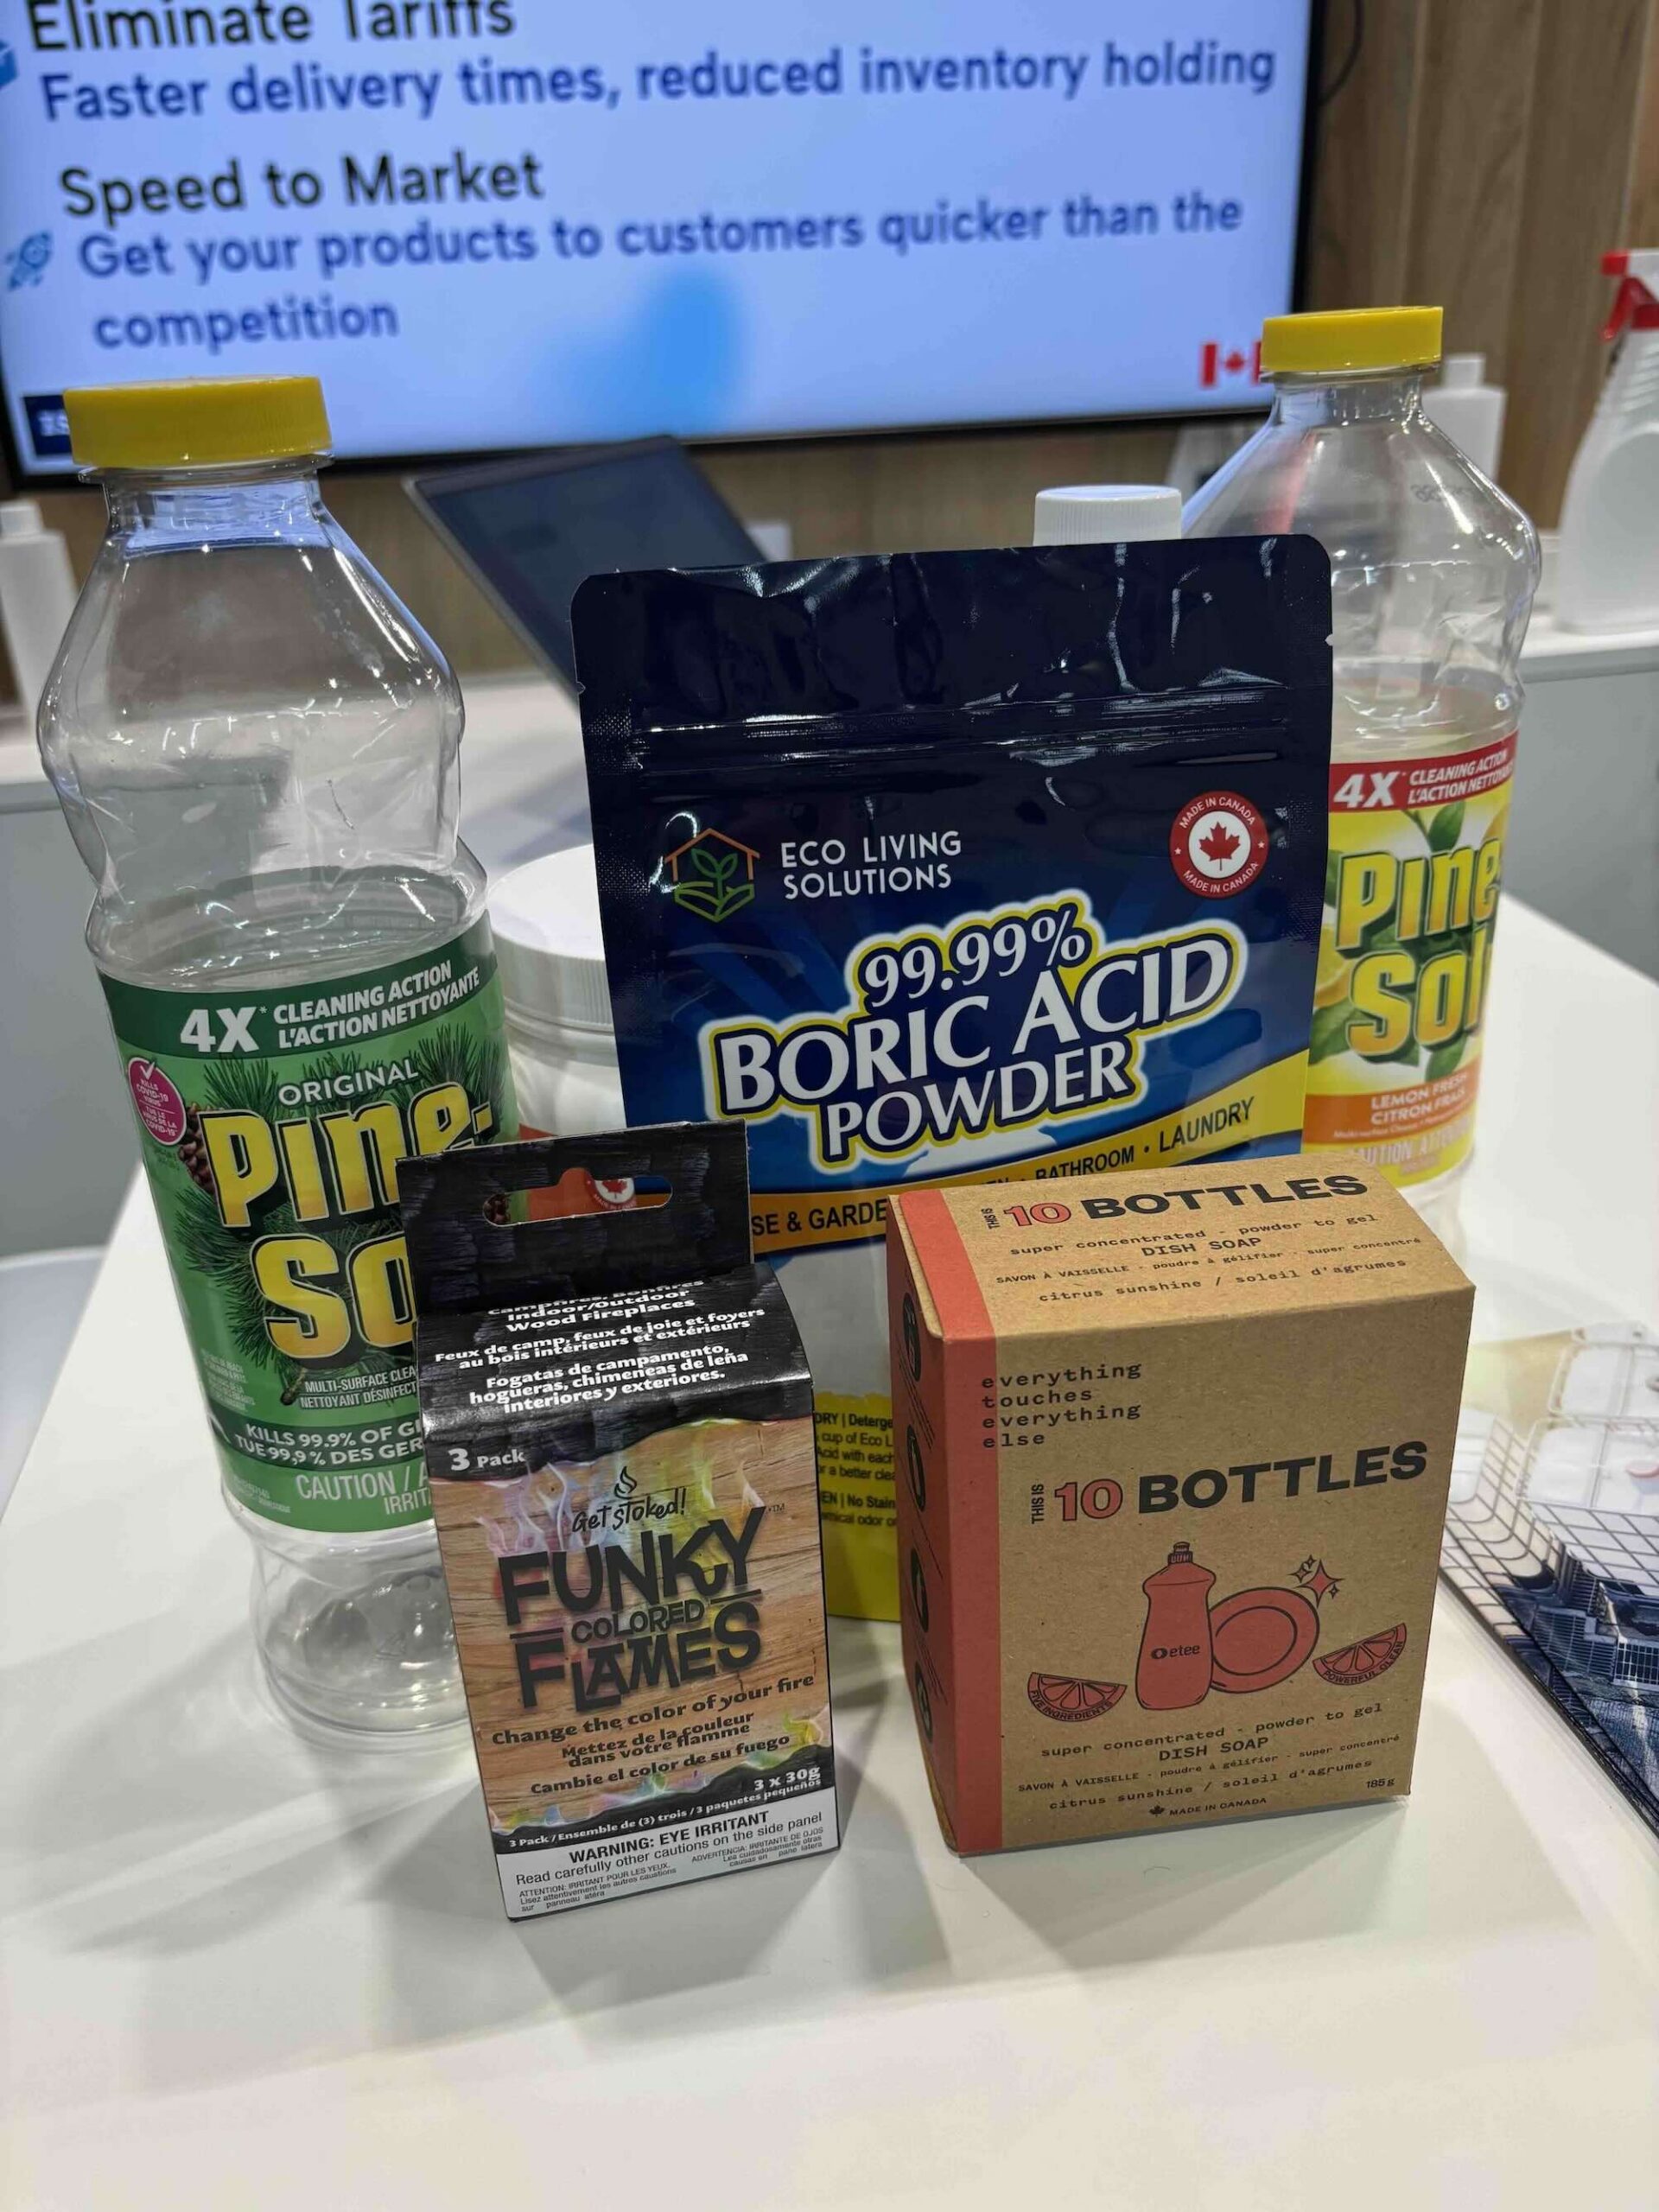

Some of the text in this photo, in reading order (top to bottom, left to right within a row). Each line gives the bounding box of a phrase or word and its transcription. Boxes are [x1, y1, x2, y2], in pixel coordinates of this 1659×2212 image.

[27, 0, 517, 52] Eliminate Tariffs
[41, 40, 1276, 122] Faster delivery times, reduced inventory holding
[60, 148, 543, 225] Speed to Market
[79, 190, 1243, 284] Get your products to customers quicker than the
[94, 296, 399, 354] competition
[1409, 762, 1476, 786] CLEANING
[1477, 749, 1507, 772] ACTION
[1179, 797, 1255, 829] MADE CANADA
[1408, 784, 1467, 804] L'ACTION
[781, 830, 962, 868] ECO LIVING
[784, 863, 952, 900] SOLUTIONS
[1183, 861, 1259, 892] MADE CANADA
[864, 903, 1085, 1009] 99.99%
[274, 987, 385, 1025] CLEANING
[389, 960, 452, 1000] ACTION
[278, 966, 480, 1049] L'ACTION NETTOYANTE
[721, 938, 1230, 1111] BORIC ACID
[278, 1060, 418, 1106] ORIGINAL
[828, 1041, 1128, 1158] POWDER
[1371, 1089, 1428, 1109] LEMON
[1159, 1096, 1255, 1155] LAUNDRY
[1371, 1104, 1432, 1125] CITRON
[1003, 1175, 1368, 1227] 10 BOTTLES
[1010, 1222, 1301, 1255] super concentrated powder
[1141, 1237, 1262, 1257] DISH SOAP
[1039, 1259, 1407, 1302] citrus sunshine soleil d'agrumes
[1058, 1265, 1129, 1278] VAISSELLE
[435, 1308, 766, 1363] Feux camp, feux foyers
[505, 1299, 695, 1332] Wood Fireplaces
[490, 1319, 750, 1366] bois intérieurs extérieurs
[305, 1373, 389, 1393] MULTI-SURFACE
[470, 1351, 748, 1405] hogueras, chimeneas leña
[486, 1344, 730, 1392] Fogatas campamento,
[982, 1361, 1142, 1389] everything
[301, 1394, 360, 1408] NETTOYANT
[504, 1371, 725, 1414] interiores exteriores.
[982, 1387, 1093, 1408] touches
[246, 1424, 391, 1447] KILLS 99.9% OF
[982, 1402, 1141, 1430] everything
[235, 1434, 374, 1465] TUE DES
[448, 1447, 525, 1471] 3 Pack
[822, 1433, 881, 1446] cup Eco
[982, 1430, 1046, 1450] else
[296, 1470, 392, 1500] CAUTION
[1053, 1440, 1427, 1522] 10 BOTTLES
[498, 1506, 766, 1625] FUNKY
[571, 1599, 704, 1643] COLORED
[514, 1601, 761, 1712] FLAMES
[1169, 1644, 1200, 1658] etee
[1323, 1642, 1403, 1684] POWERFUL CLEAN
[493, 1675, 814, 1745] Change the color of your fire
[1030, 1689, 1113, 1720] FIVE INGREDIENTS
[562, 1713, 754, 1759] Mettez couleur
[569, 1724, 750, 1768] dans votre flamme
[1041, 1703, 1382, 1758] super concentrated powder gel
[1159, 1737, 1269, 1762] DISH SOAP
[531, 1735, 790, 1794] Cambie el color su fuego
[786, 1766, 821, 1781] 30g
[1018, 1772, 1140, 1793] SAVON VAISSELLE
[1049, 1759, 1372, 1810] citrus sunshine soleil d'agrumes
[558, 1792, 760, 1840] Ensemble paquetes
[1169, 1797, 1267, 1816] MADE CANADA
[516, 1811, 823, 1885] Read carefully other cautions on the side panel
[569, 1810, 769, 1863] WARNING: EYE IRRITANT
[519, 1885, 567, 1897] ATTENTION:
